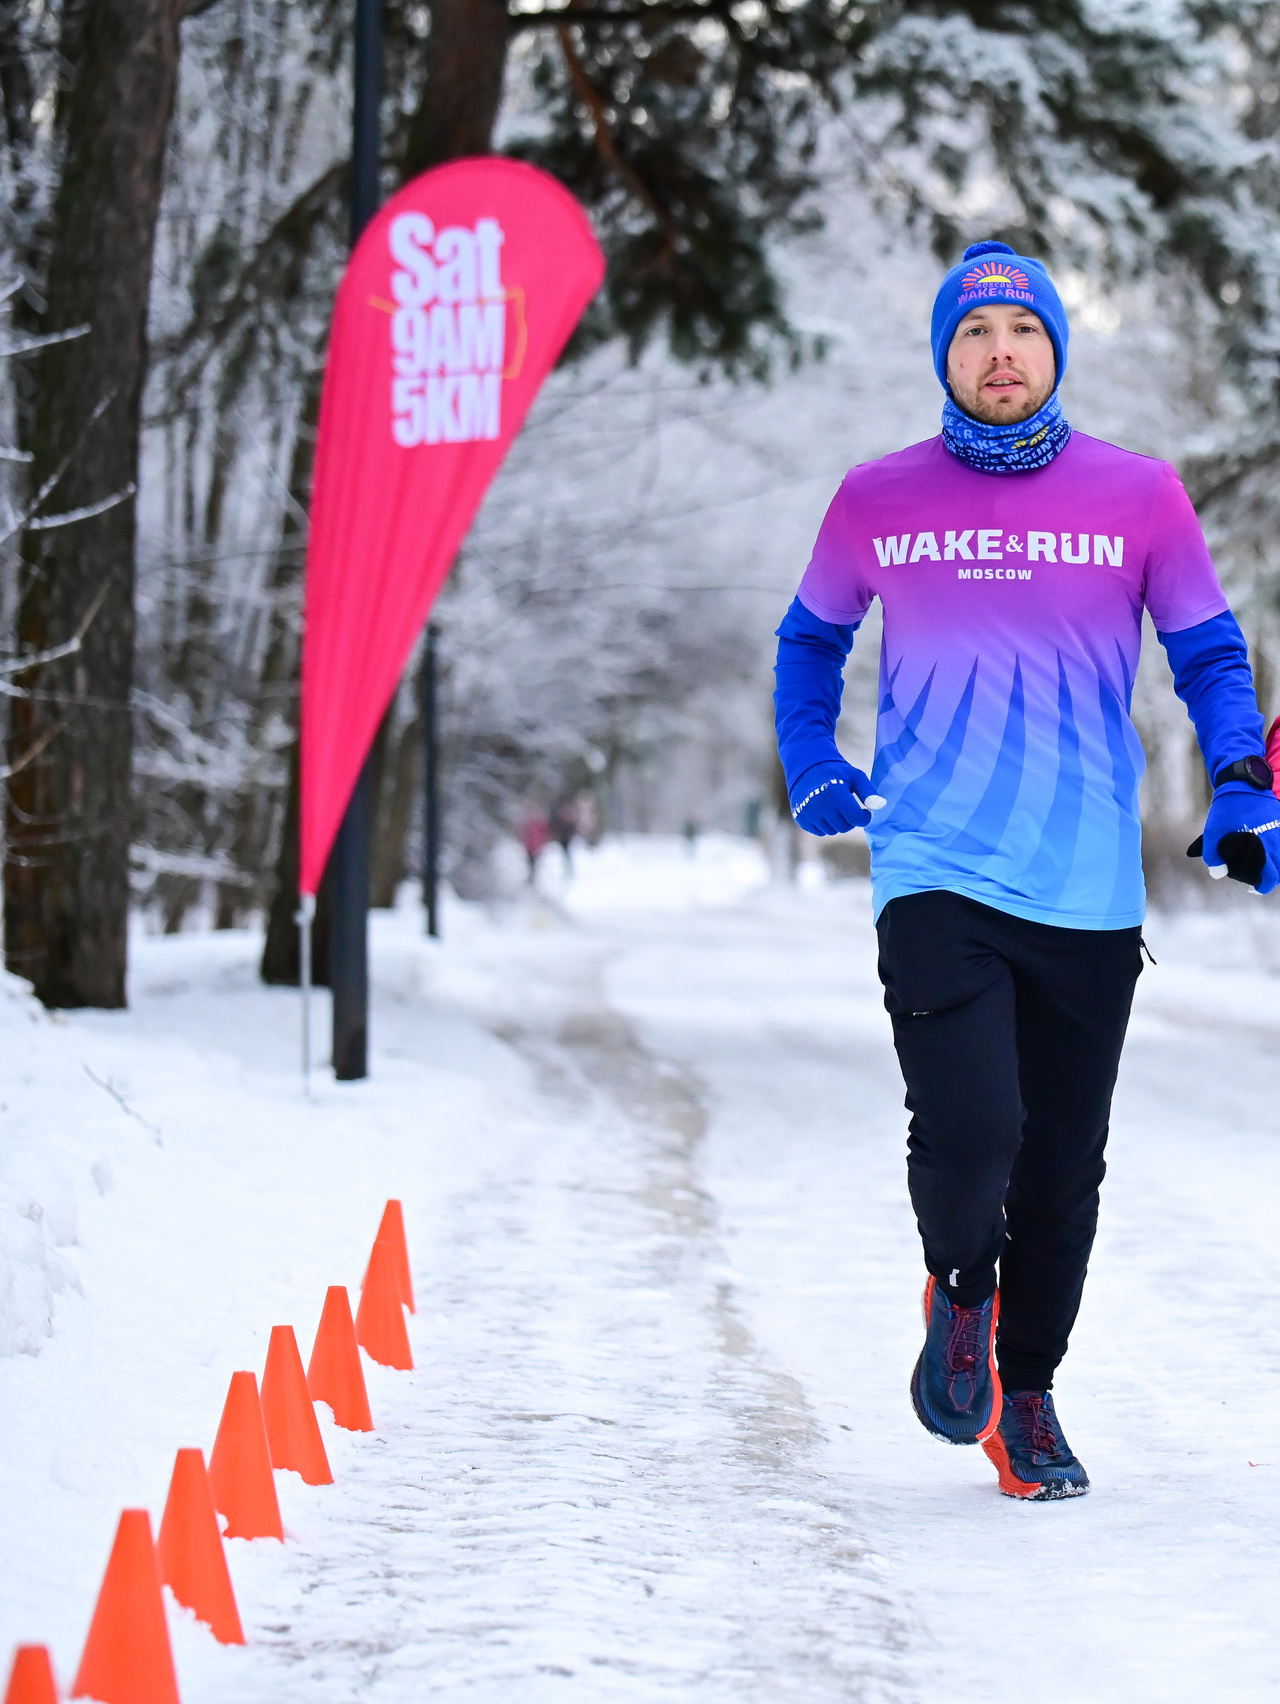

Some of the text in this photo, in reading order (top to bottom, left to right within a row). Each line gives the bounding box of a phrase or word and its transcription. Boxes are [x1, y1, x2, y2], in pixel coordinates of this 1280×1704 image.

[389, 209, 505, 307] Sat
[391, 302, 506, 378] 9AM
[391, 373, 501, 447] 5KM
[958, 568, 1032, 580] MOSCOW
